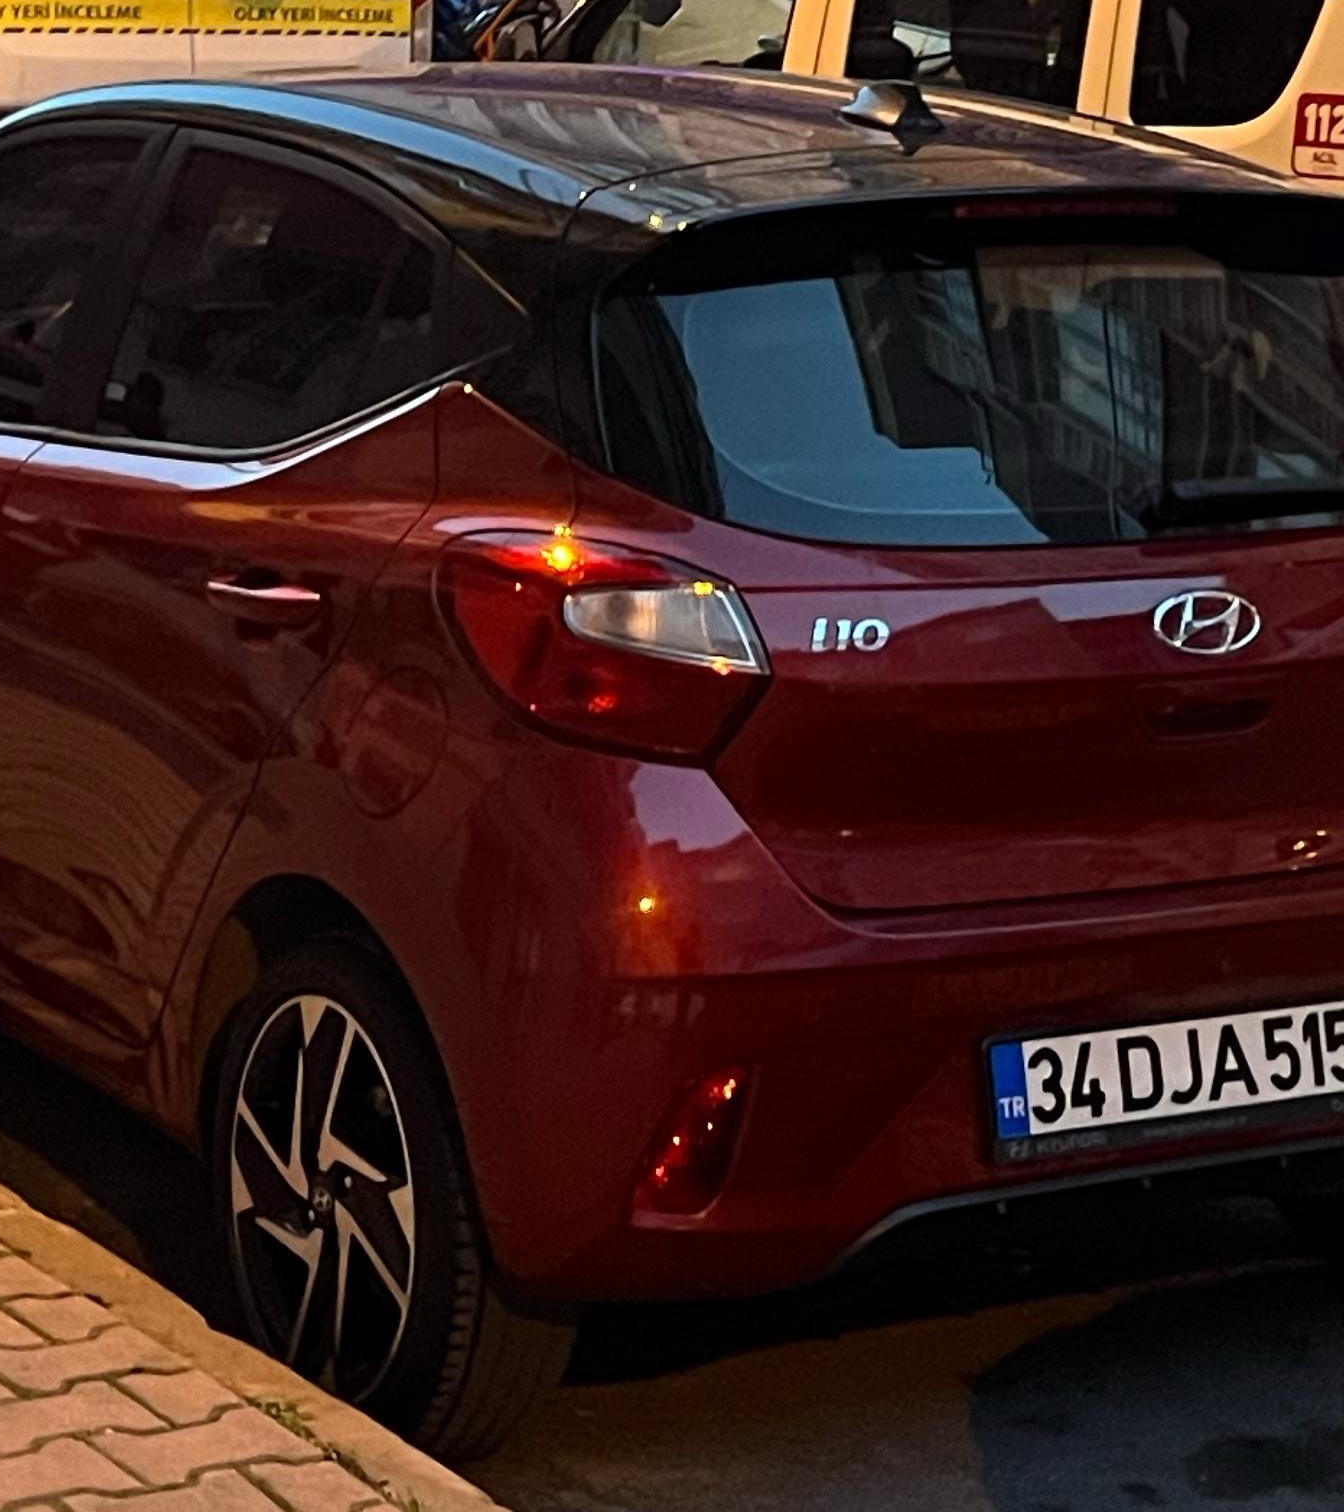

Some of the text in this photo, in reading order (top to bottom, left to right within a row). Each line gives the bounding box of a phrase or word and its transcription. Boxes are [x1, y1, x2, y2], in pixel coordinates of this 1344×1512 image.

[11, 1, 50, 19] YERİ
[54, 1, 144, 20] İNCELEME
[234, 5, 394, 24] OLAY YERİ İNCELEME
[998, 1096, 1026, 1119] TR
